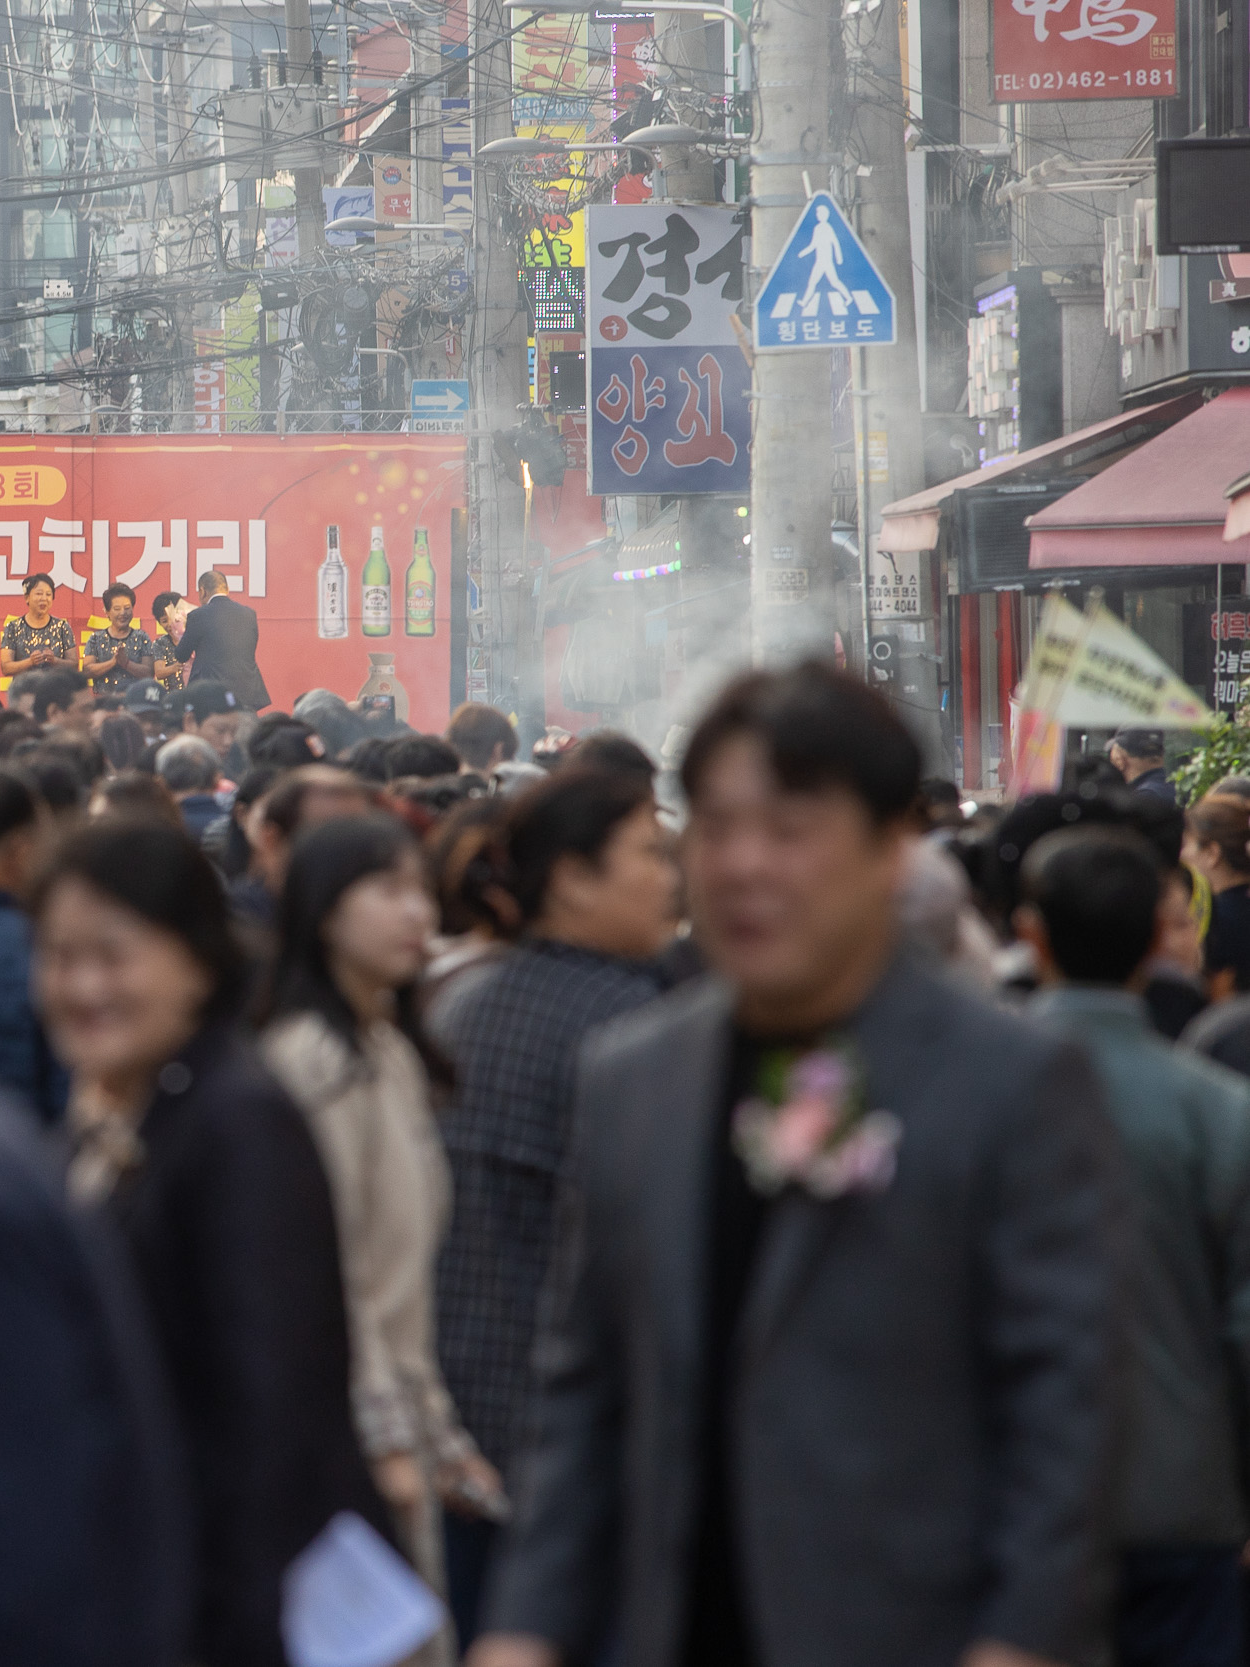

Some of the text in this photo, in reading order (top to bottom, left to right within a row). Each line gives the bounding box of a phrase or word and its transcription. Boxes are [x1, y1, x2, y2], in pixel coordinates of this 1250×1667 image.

[995, 69, 1173, 91] TEL: 02)462-1881
[777, 320, 875, 342] 횡단보도
[596, 353, 750, 476] 양꼬
